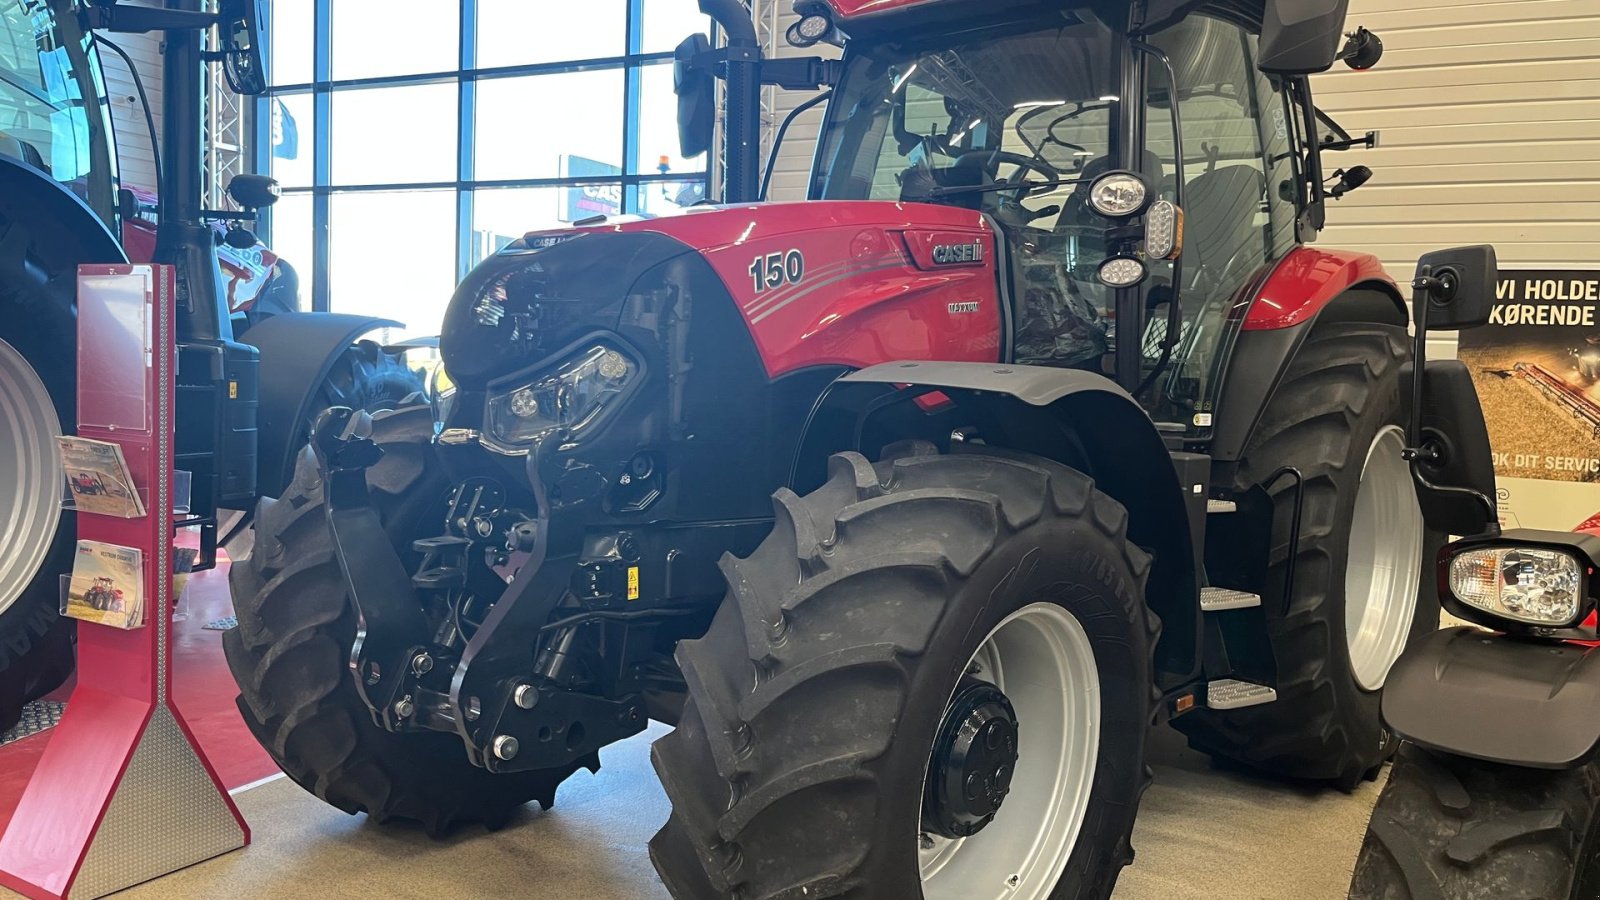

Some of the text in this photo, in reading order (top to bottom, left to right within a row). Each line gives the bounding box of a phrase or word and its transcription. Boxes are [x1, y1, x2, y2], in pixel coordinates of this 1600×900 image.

[583, 185, 621, 202] CAS
[748, 248, 804, 294] 150
[1496, 279, 1600, 301] VI HOLDE
[948, 302, 979, 314] MAXXUM
[1488, 303, 1596, 326] KØRENDE
[1515, 453, 1540, 468] DIT
[1545, 456, 1600, 473] SERVIC
